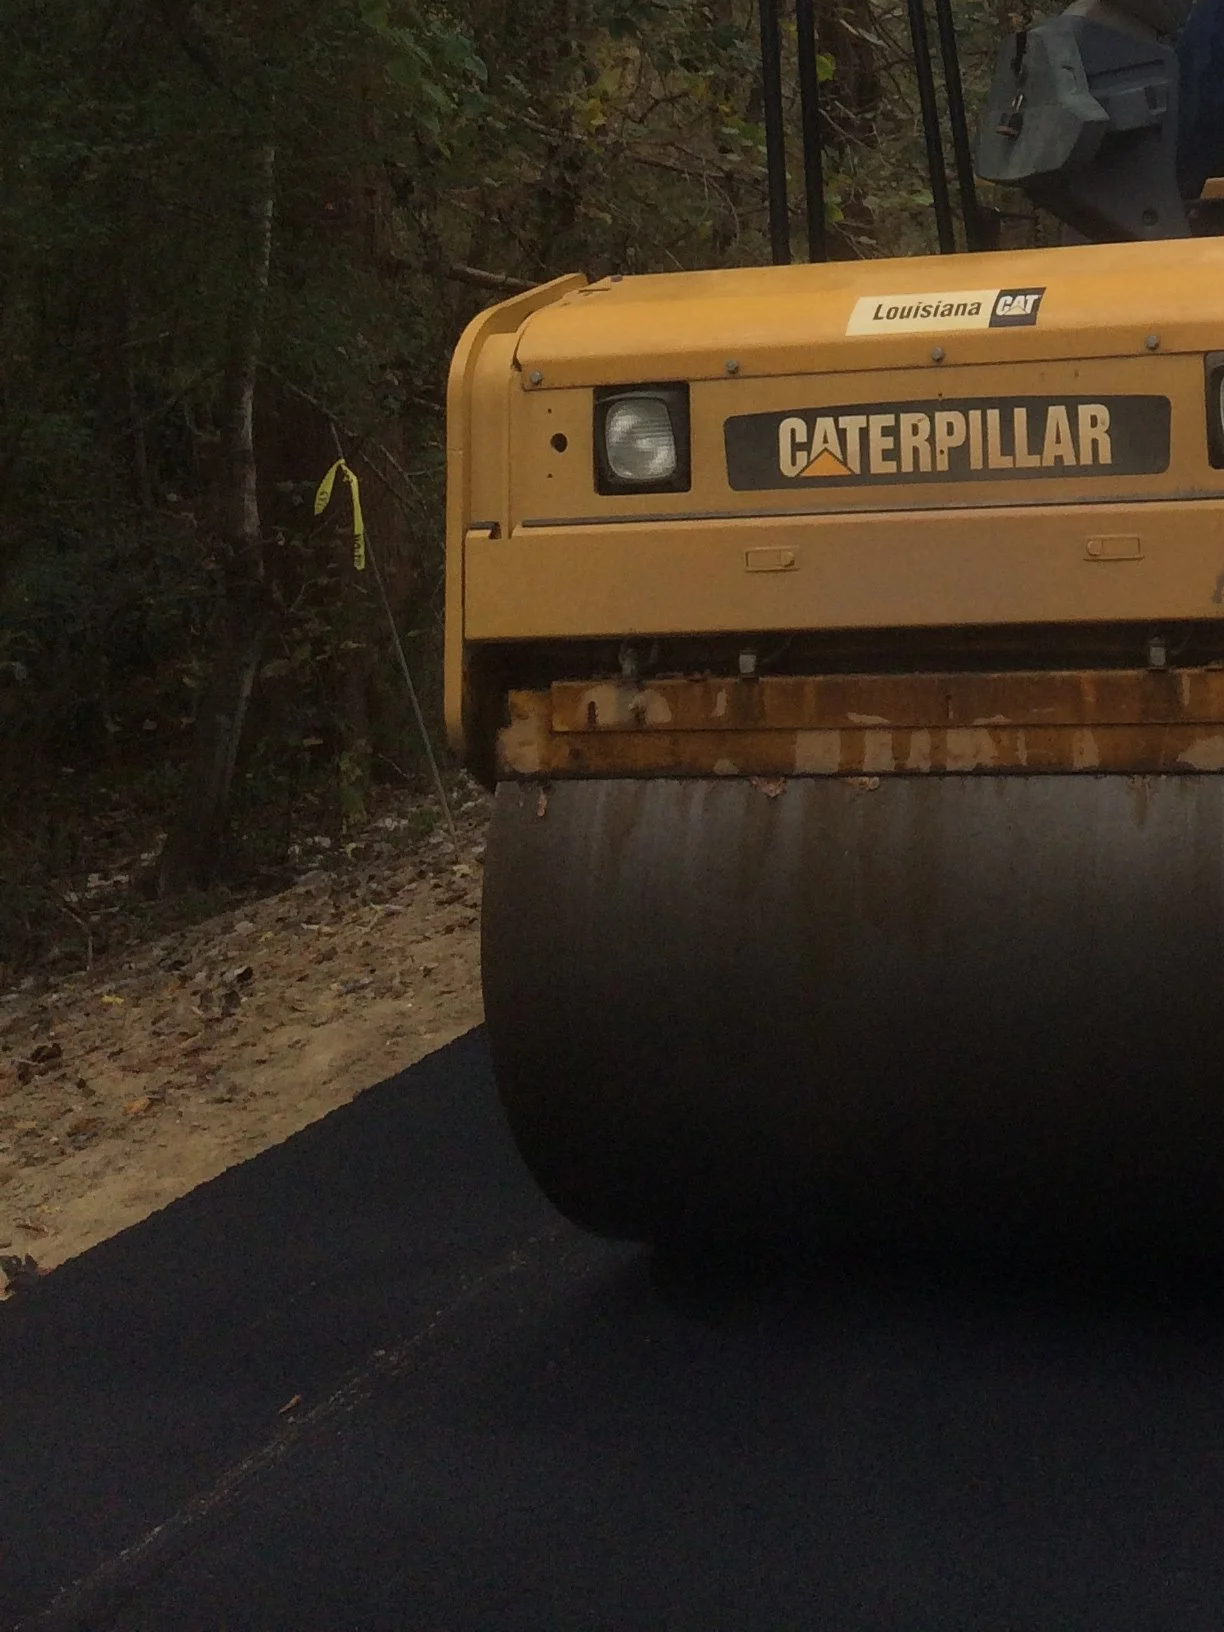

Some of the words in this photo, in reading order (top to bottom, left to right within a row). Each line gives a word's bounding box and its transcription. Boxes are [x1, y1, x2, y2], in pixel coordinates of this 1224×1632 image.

[873, 300, 982, 320] Louisiana
[996, 294, 1041, 316] CAT
[778, 403, 1112, 477] CATERPILLAR
